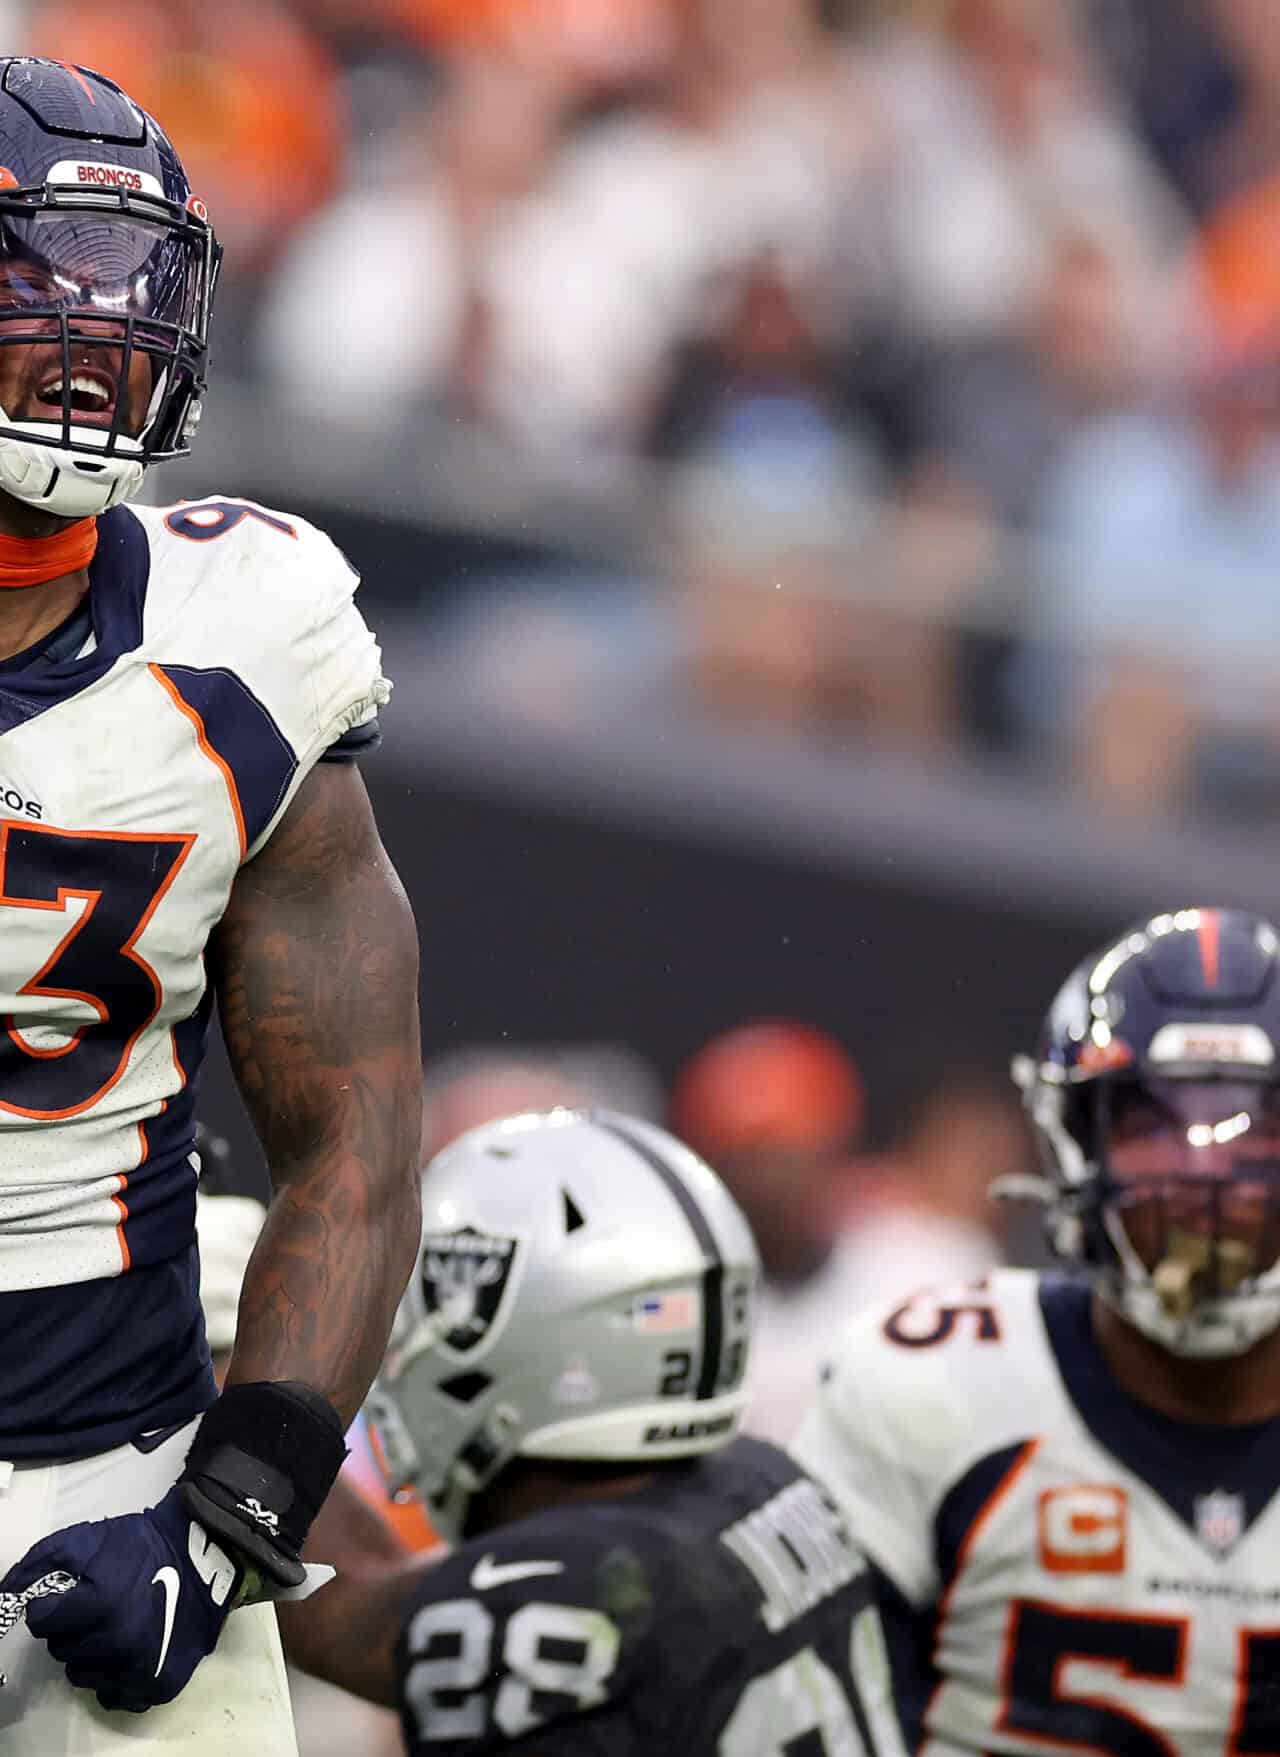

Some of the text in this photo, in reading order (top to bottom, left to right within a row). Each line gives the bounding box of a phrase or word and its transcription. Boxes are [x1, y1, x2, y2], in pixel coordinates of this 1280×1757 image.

[78, 166, 142, 189] BRONCOS
[1046, 1495, 1121, 1556] C
[405, 1599, 620, 1740] 28
